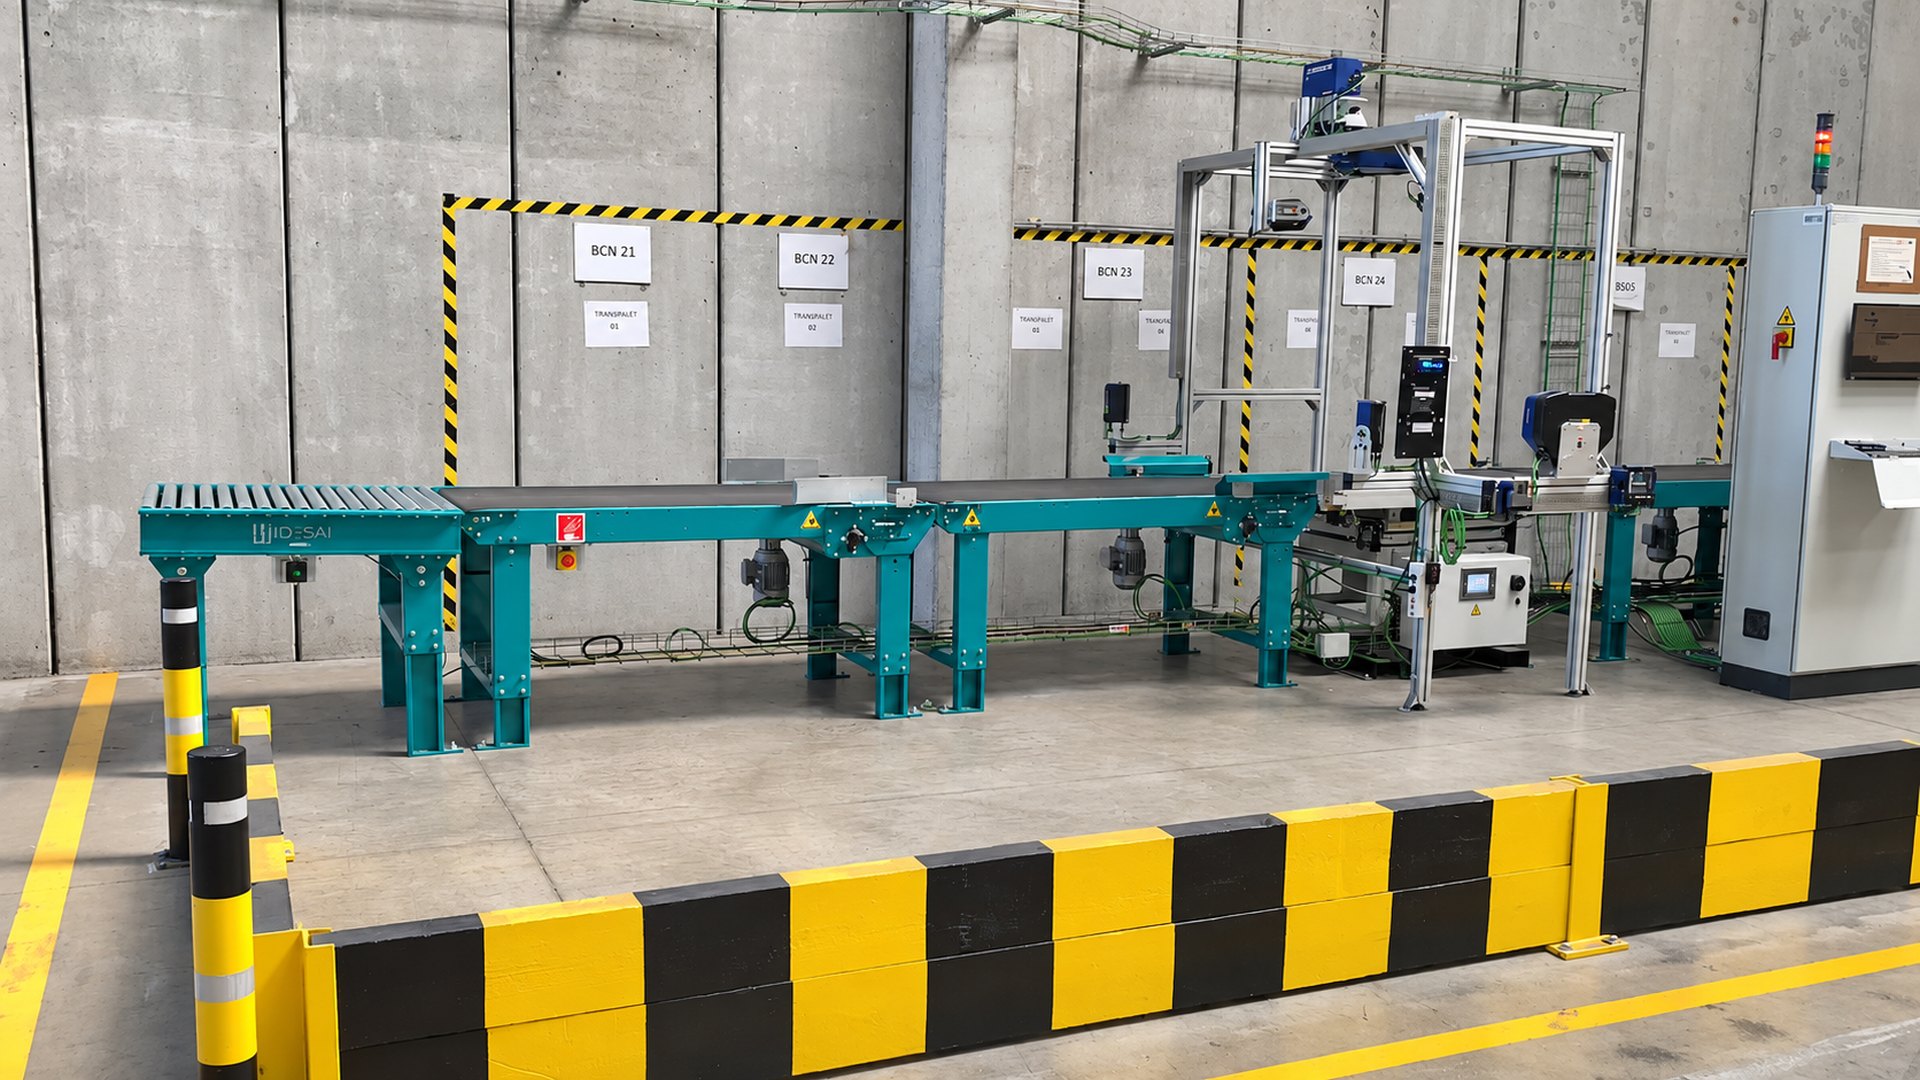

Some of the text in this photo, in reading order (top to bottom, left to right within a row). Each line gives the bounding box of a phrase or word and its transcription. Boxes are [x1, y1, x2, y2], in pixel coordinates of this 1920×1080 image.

[591, 244, 636, 258] BCN 21
[794, 252, 835, 265] BCN 22
[1097, 266, 1132, 278] BCN 23
[1355, 275, 1386, 286] BCN 24
[594, 310, 638, 318] TRANSPALET
[793, 312, 833, 320] TRANSPALET
[609, 322, 619, 330] 01
[274, 526, 331, 539] IDESAI
